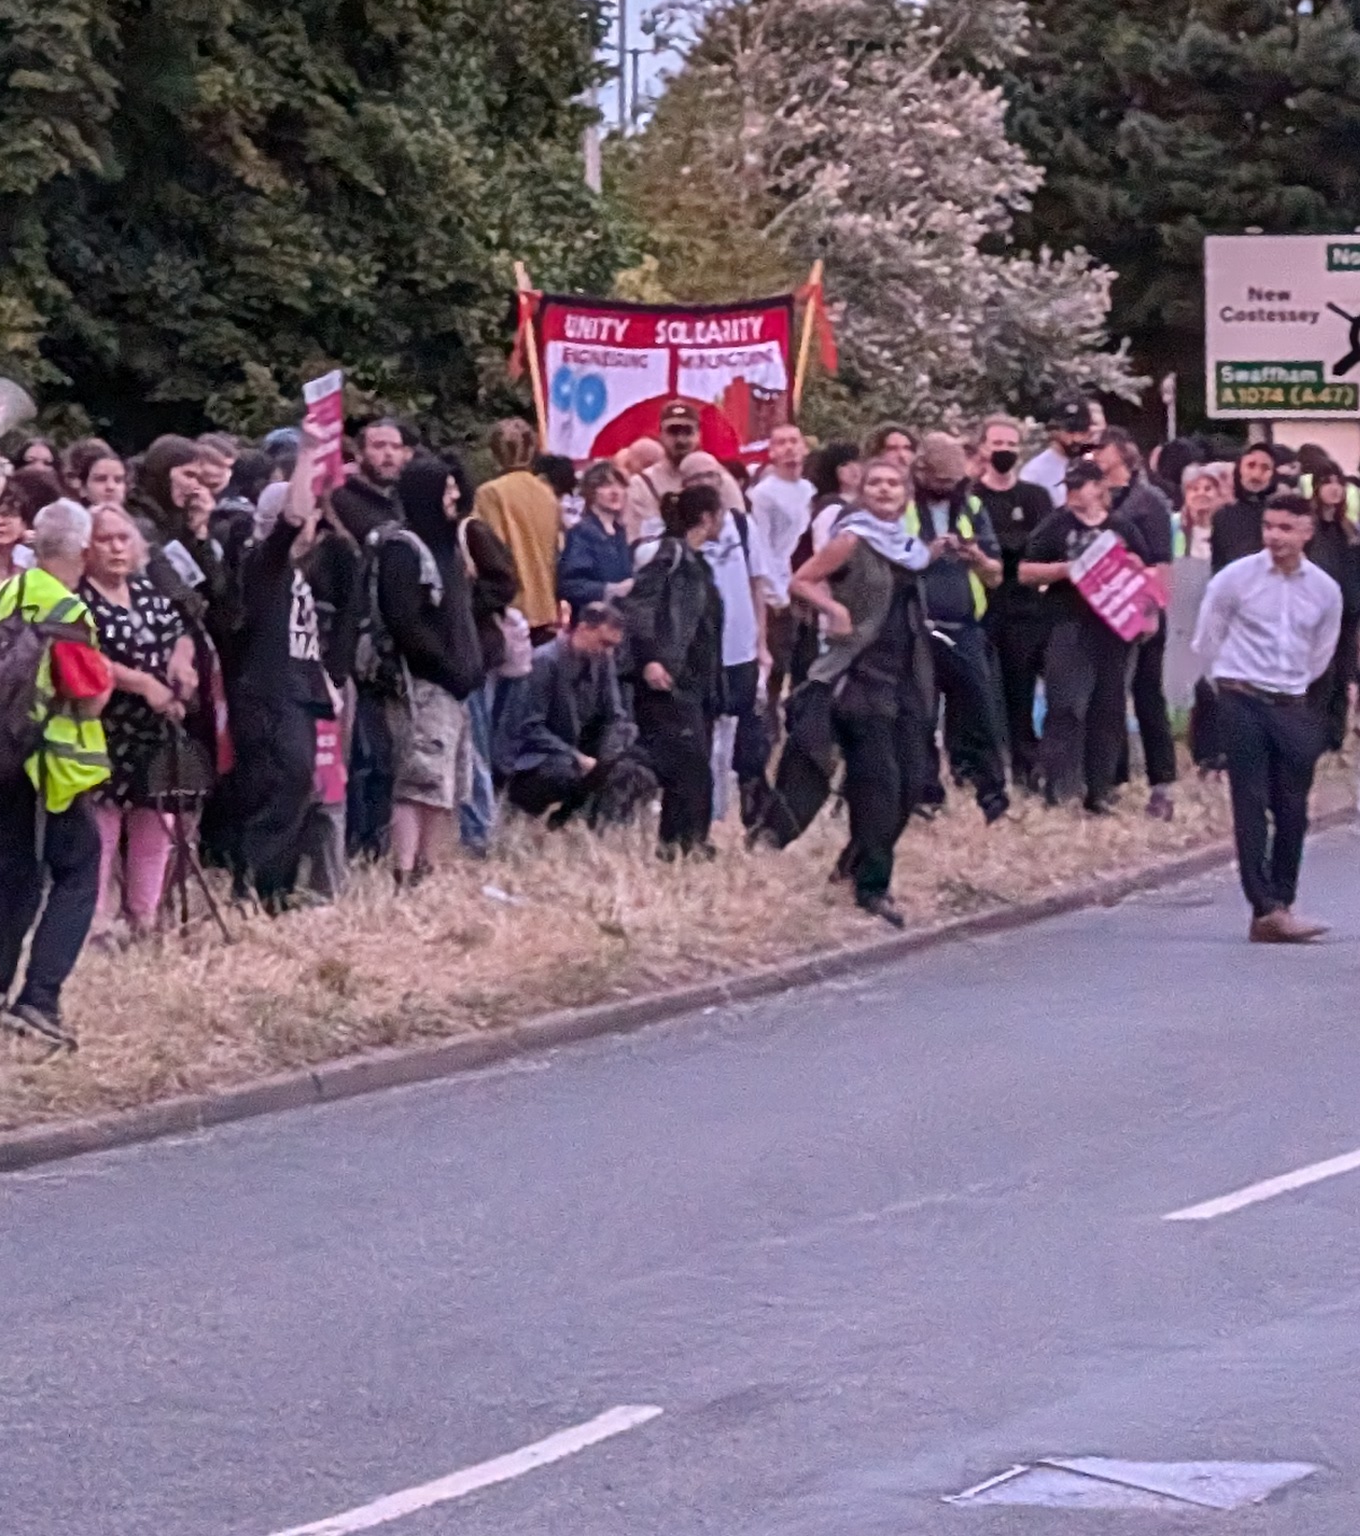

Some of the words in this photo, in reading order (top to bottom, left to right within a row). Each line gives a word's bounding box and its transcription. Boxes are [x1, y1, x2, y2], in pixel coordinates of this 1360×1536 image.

[1247, 286, 1290, 302] New
[1219, 306, 1320, 324] Costessey
[1220, 366, 1318, 383] Swaffham
